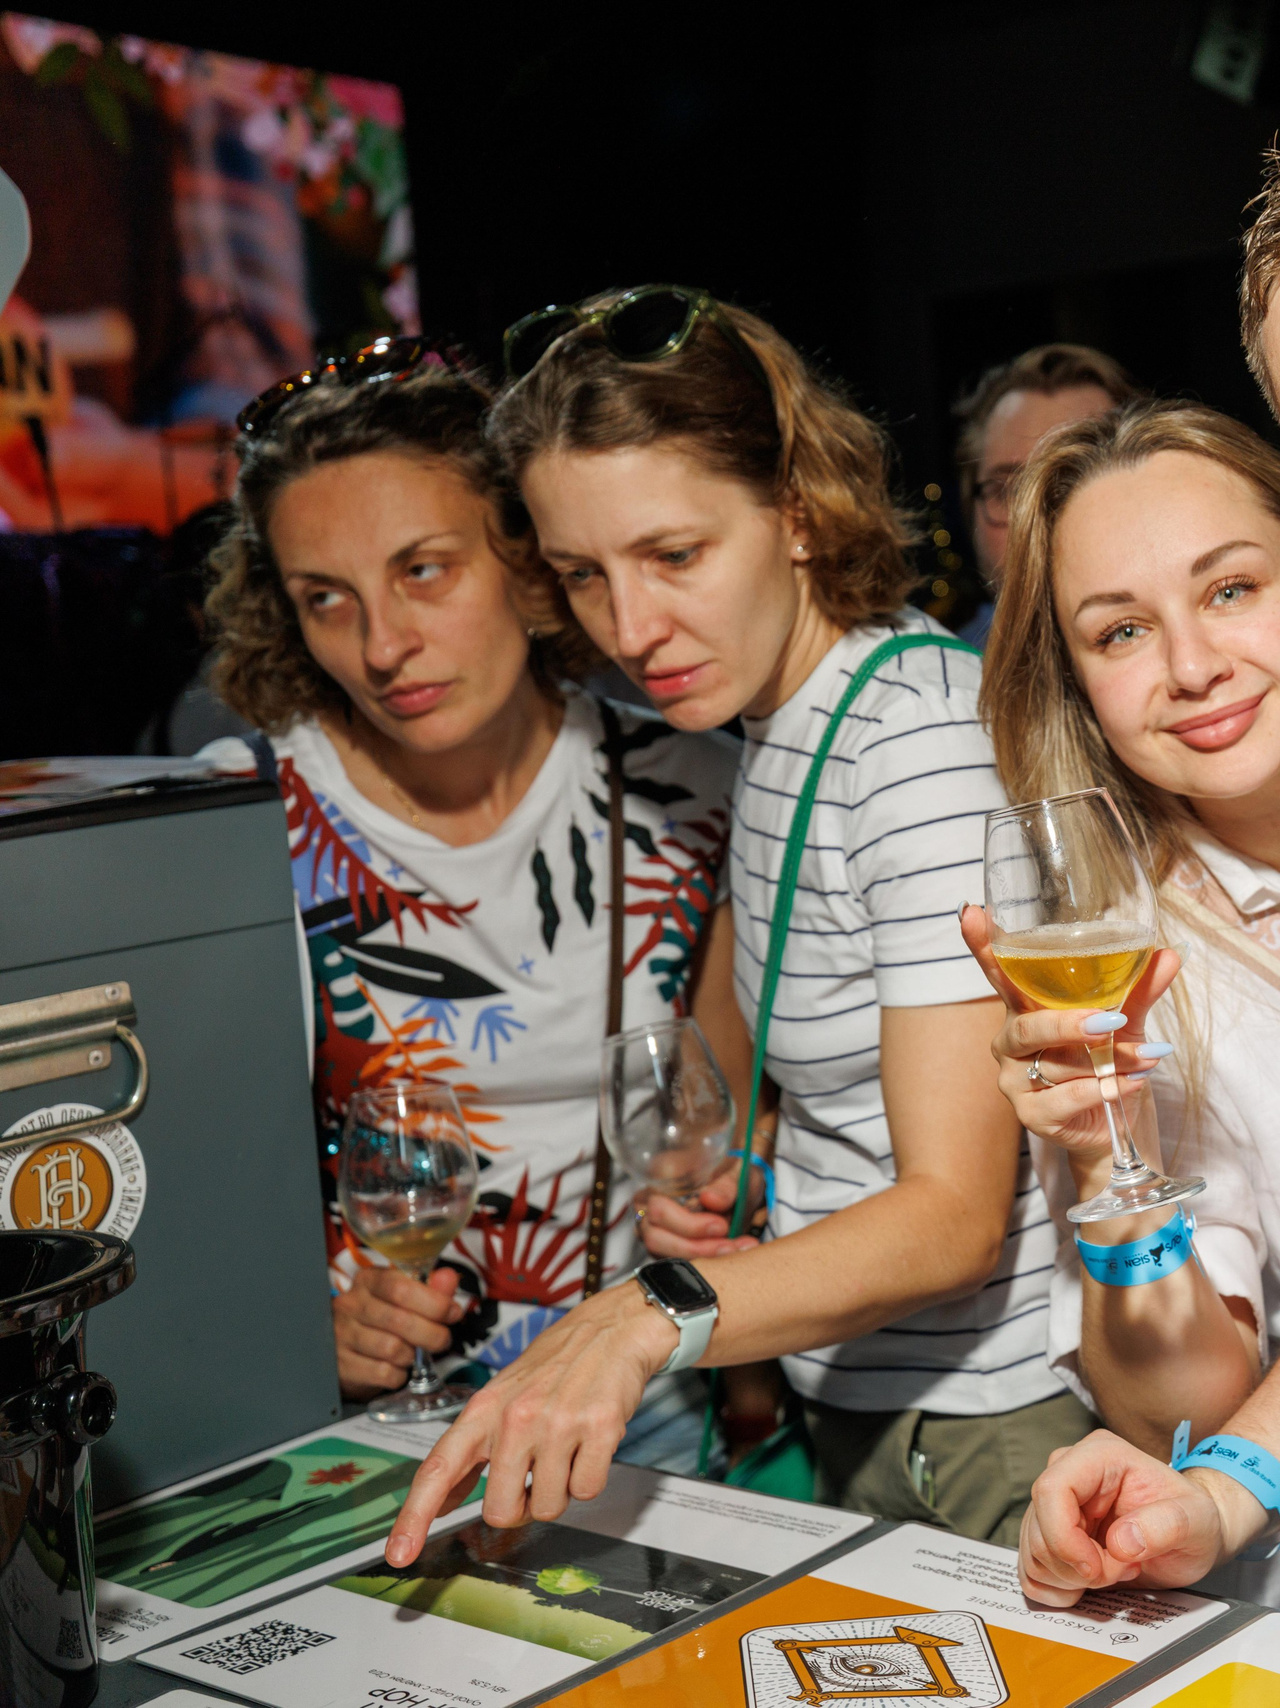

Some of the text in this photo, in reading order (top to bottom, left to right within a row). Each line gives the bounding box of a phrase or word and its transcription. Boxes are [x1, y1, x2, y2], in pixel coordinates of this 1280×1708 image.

[642, 1588, 676, 1601] HOP
[672, 1596, 694, 1606] OF
[634, 1596, 683, 1613] HEART
[965, 1595, 1102, 1633] TOKSOVO CIDRERIE
[367, 1687, 429, 1708] HOP
